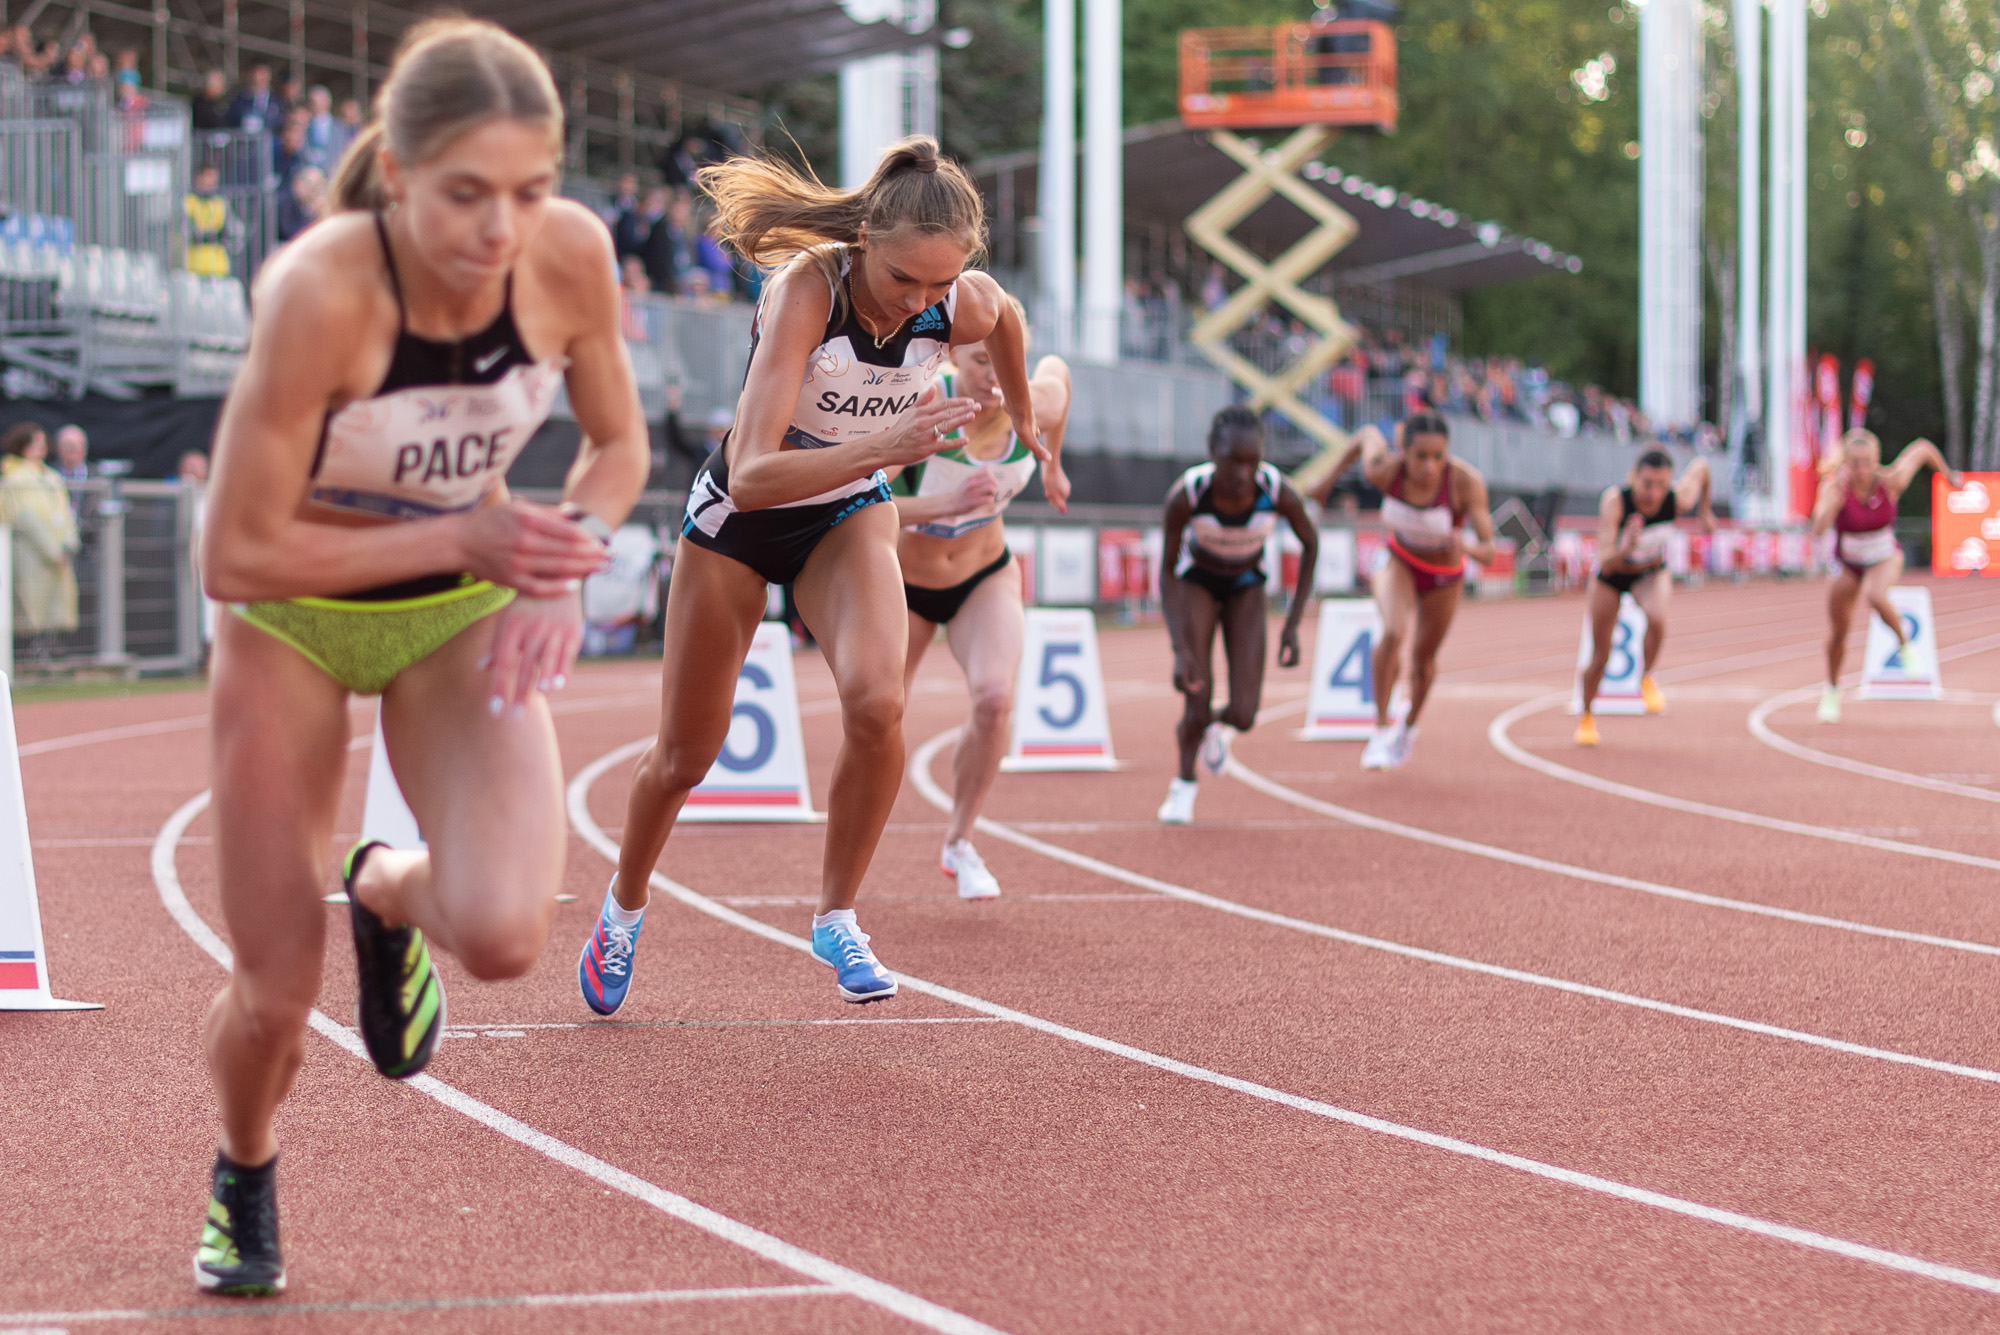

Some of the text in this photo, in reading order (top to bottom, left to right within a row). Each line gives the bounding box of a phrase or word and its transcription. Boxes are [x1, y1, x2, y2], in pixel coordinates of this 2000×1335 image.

[912, 320, 945, 333] adidas
[816, 391, 919, 417] SARNA
[394, 426, 513, 482] PACE
[693, 481, 725, 519] 7
[1038, 641, 1086, 730] 5
[1328, 629, 1374, 704] 4
[715, 662, 777, 773] 6
